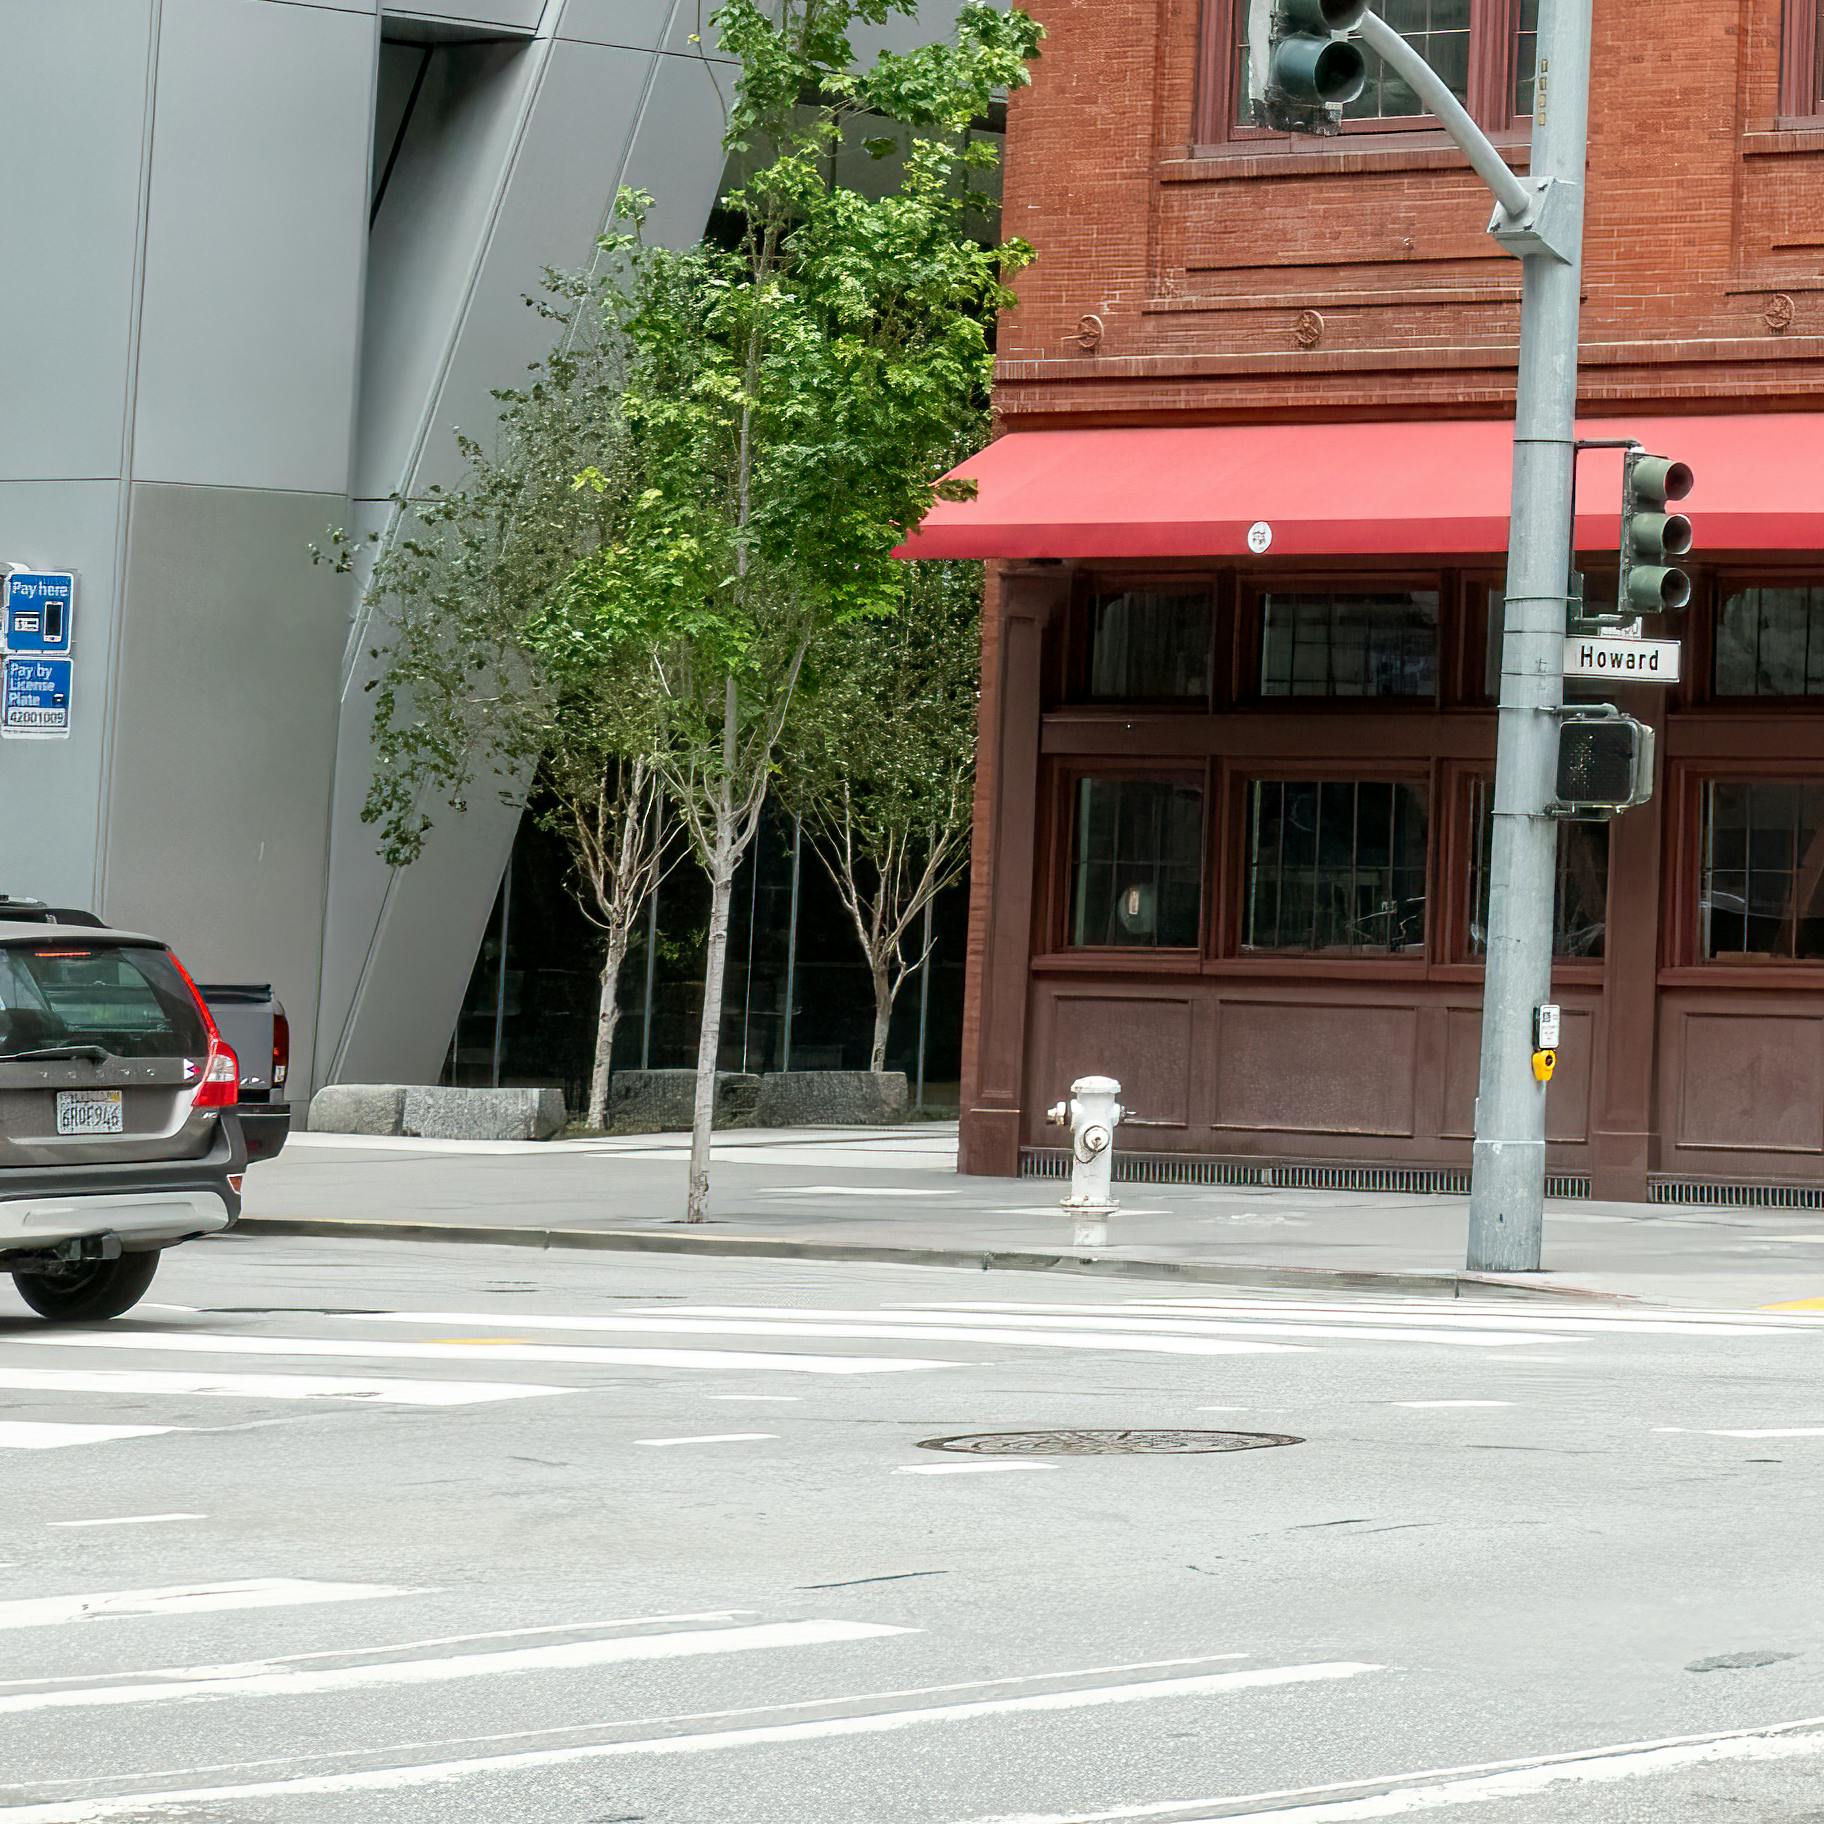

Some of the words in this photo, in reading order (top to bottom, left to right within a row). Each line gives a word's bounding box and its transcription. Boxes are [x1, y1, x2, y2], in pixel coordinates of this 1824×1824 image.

[12, 581, 37, 599] Pay
[38, 581, 68, 597] here
[1580, 645, 1659, 671] Howard
[10, 662, 33, 680] Pay
[36, 662, 53, 679] by
[9, 678, 56, 692] License
[8, 692, 41, 707] Plate
